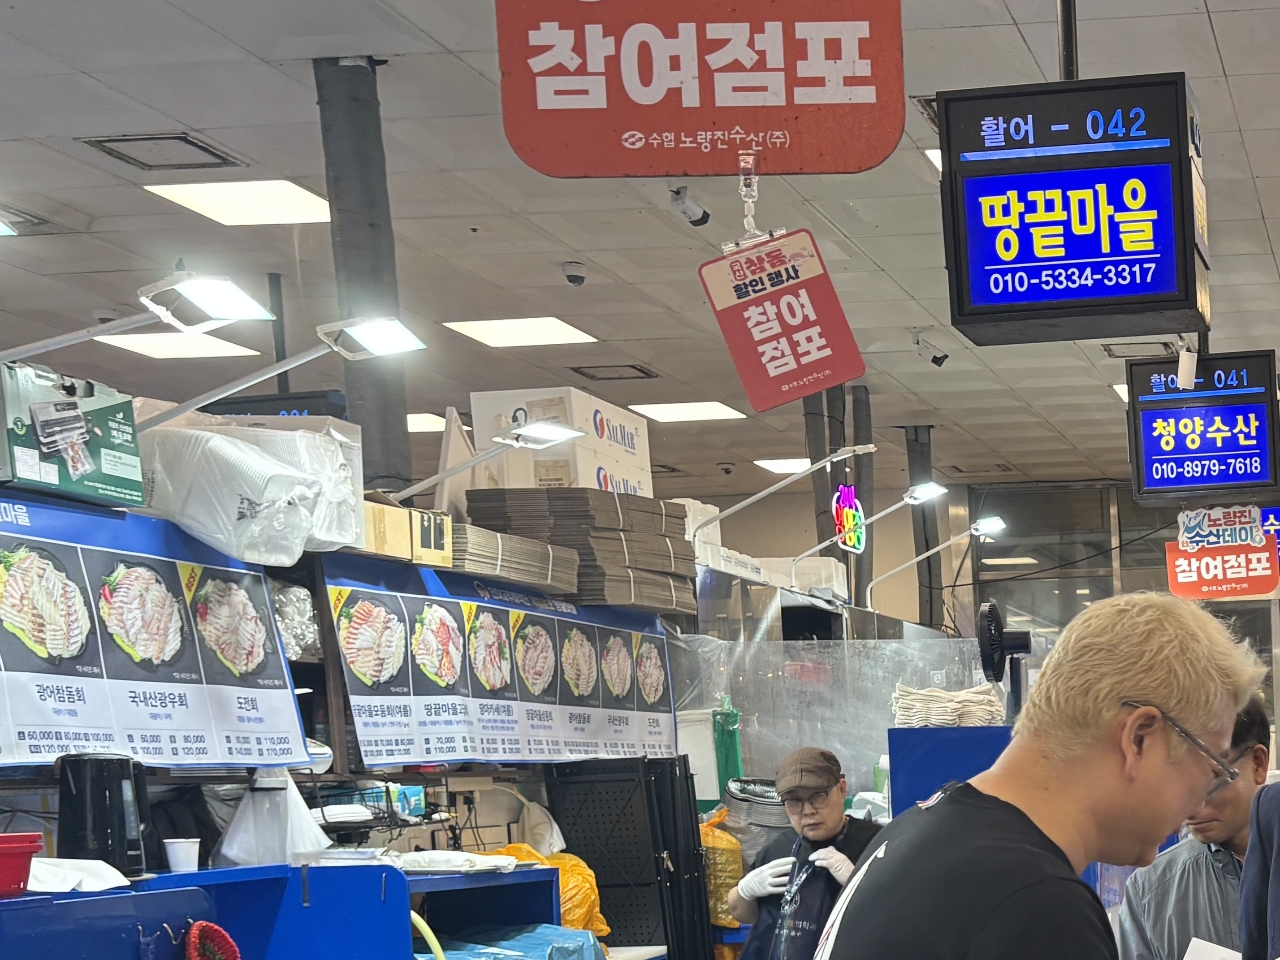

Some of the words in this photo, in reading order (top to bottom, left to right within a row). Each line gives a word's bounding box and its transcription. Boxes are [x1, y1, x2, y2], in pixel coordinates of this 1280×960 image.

[527, 21, 876, 110] 참여점포
[648, 131, 676, 149] 수협
[679, 126, 790, 152] 노량진수산(주)
[980, 114, 1034, 147] 활어
[1086, 107, 1147, 139] 042
[979, 178, 1158, 261] 땅끝마을
[732, 280, 767, 300] 할인
[767, 265, 800, 287] 행사
[989, 263, 1157, 294] 010-5334-3317
[743, 288, 817, 341] 참여
[757, 325, 832, 378] 점포
[1214, 369, 1249, 388] 041
[1152, 413, 1259, 451] 청양수산
[1152, 457, 1261, 480] 010-8979-7618
[1208, 509, 1252, 528] 노량진
[1174, 552, 1272, 583] 참여점포
[35, 683, 86, 705] 광어참돔회
[128, 690, 188, 709] 국내산광우회
